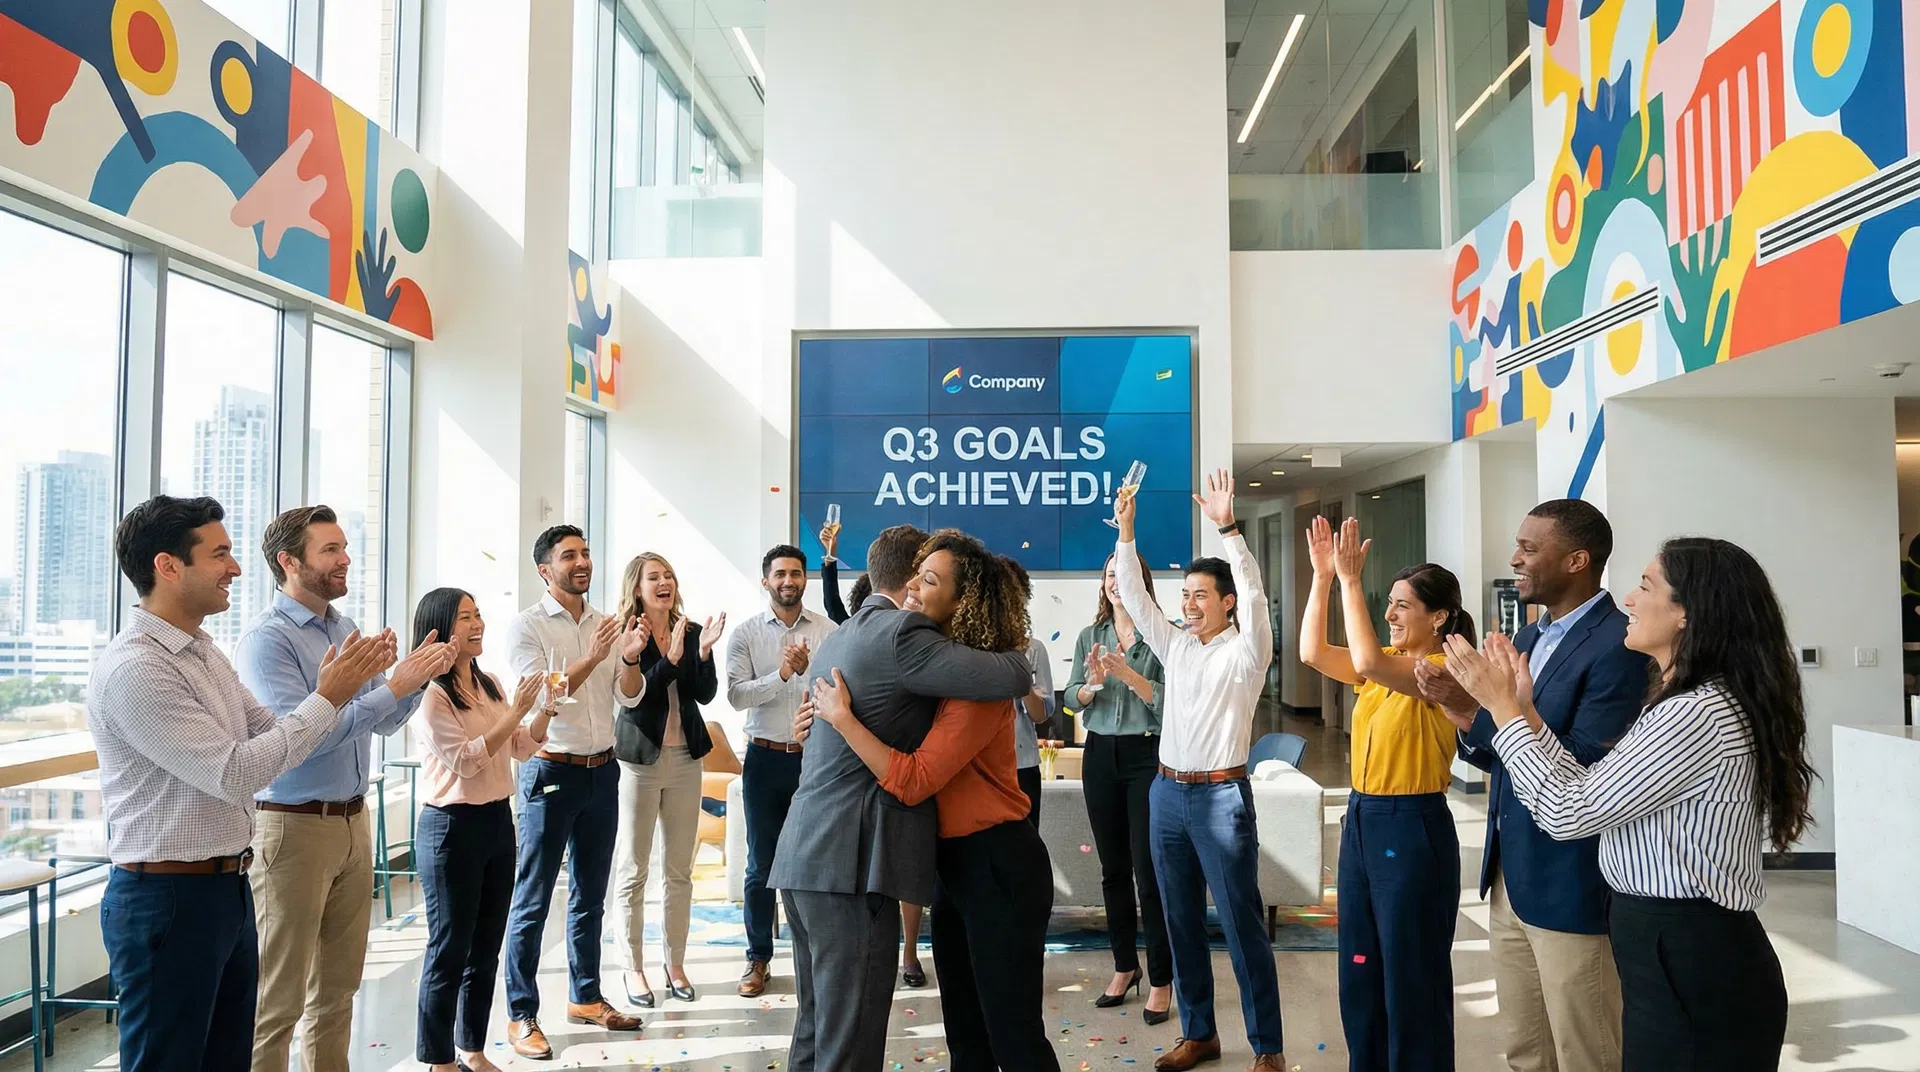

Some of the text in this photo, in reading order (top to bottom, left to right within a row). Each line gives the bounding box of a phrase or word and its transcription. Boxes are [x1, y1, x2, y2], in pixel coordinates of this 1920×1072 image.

[968, 374, 1045, 391] Company
[882, 426, 1106, 464] Q3 GOALS
[874, 471, 1112, 506] ACHIEVED!
